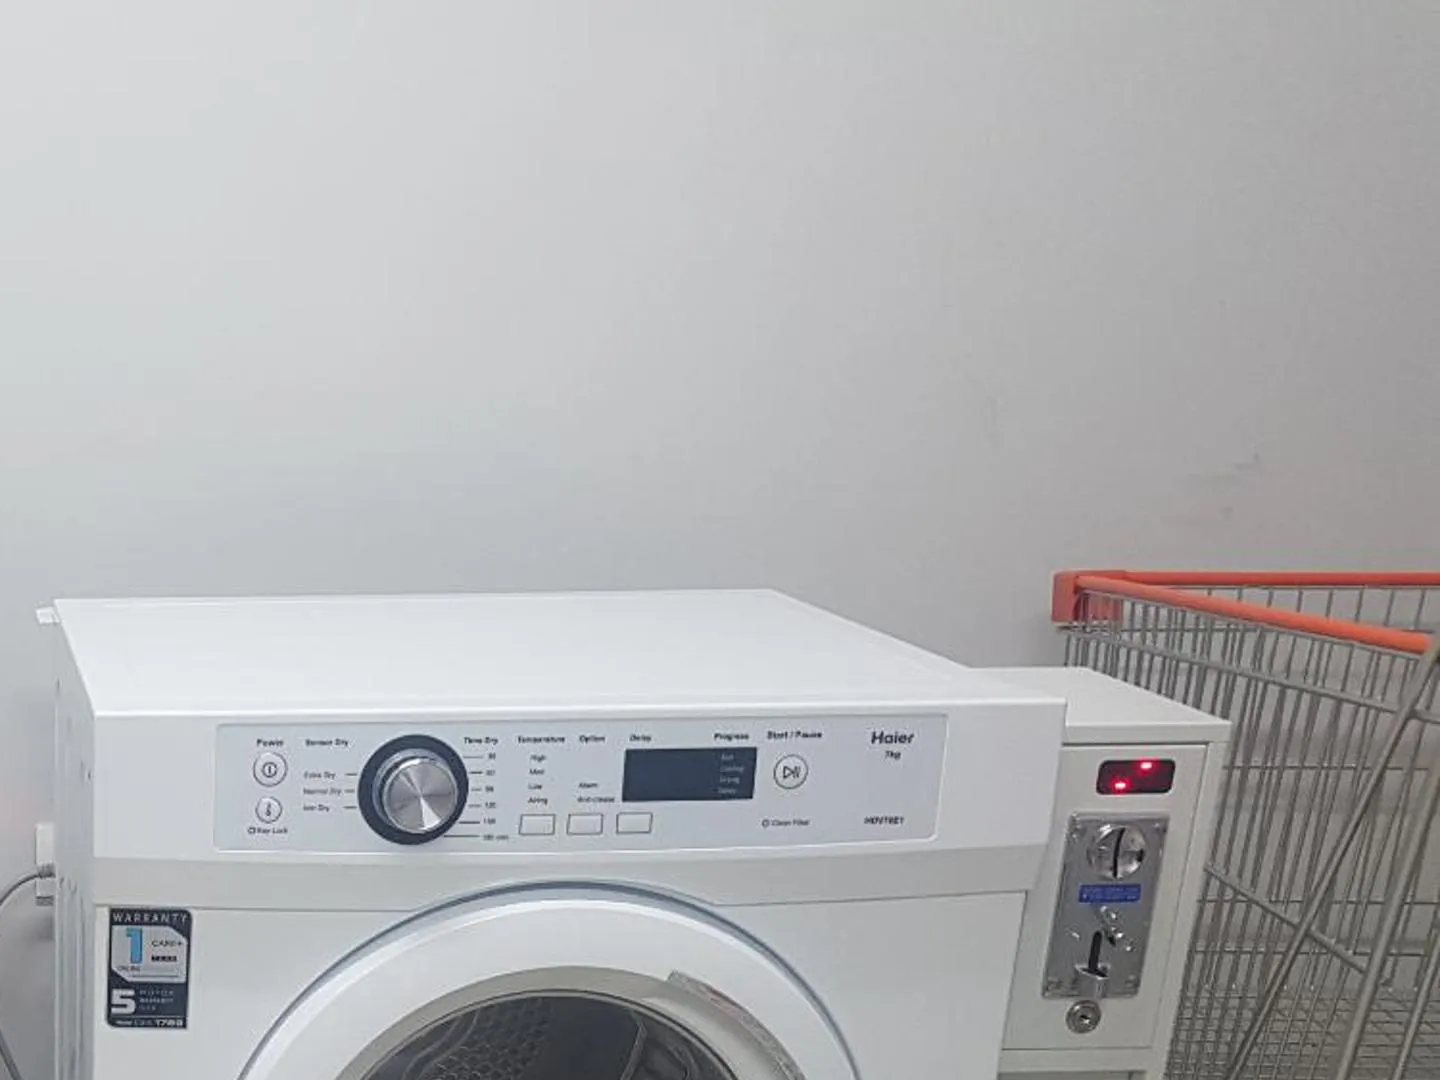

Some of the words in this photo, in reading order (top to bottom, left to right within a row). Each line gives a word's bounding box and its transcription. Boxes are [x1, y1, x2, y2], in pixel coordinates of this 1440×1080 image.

[870, 730, 914, 744] Haier
[112, 911, 189, 923] WARRANTY
[111, 988, 137, 1014] 5
